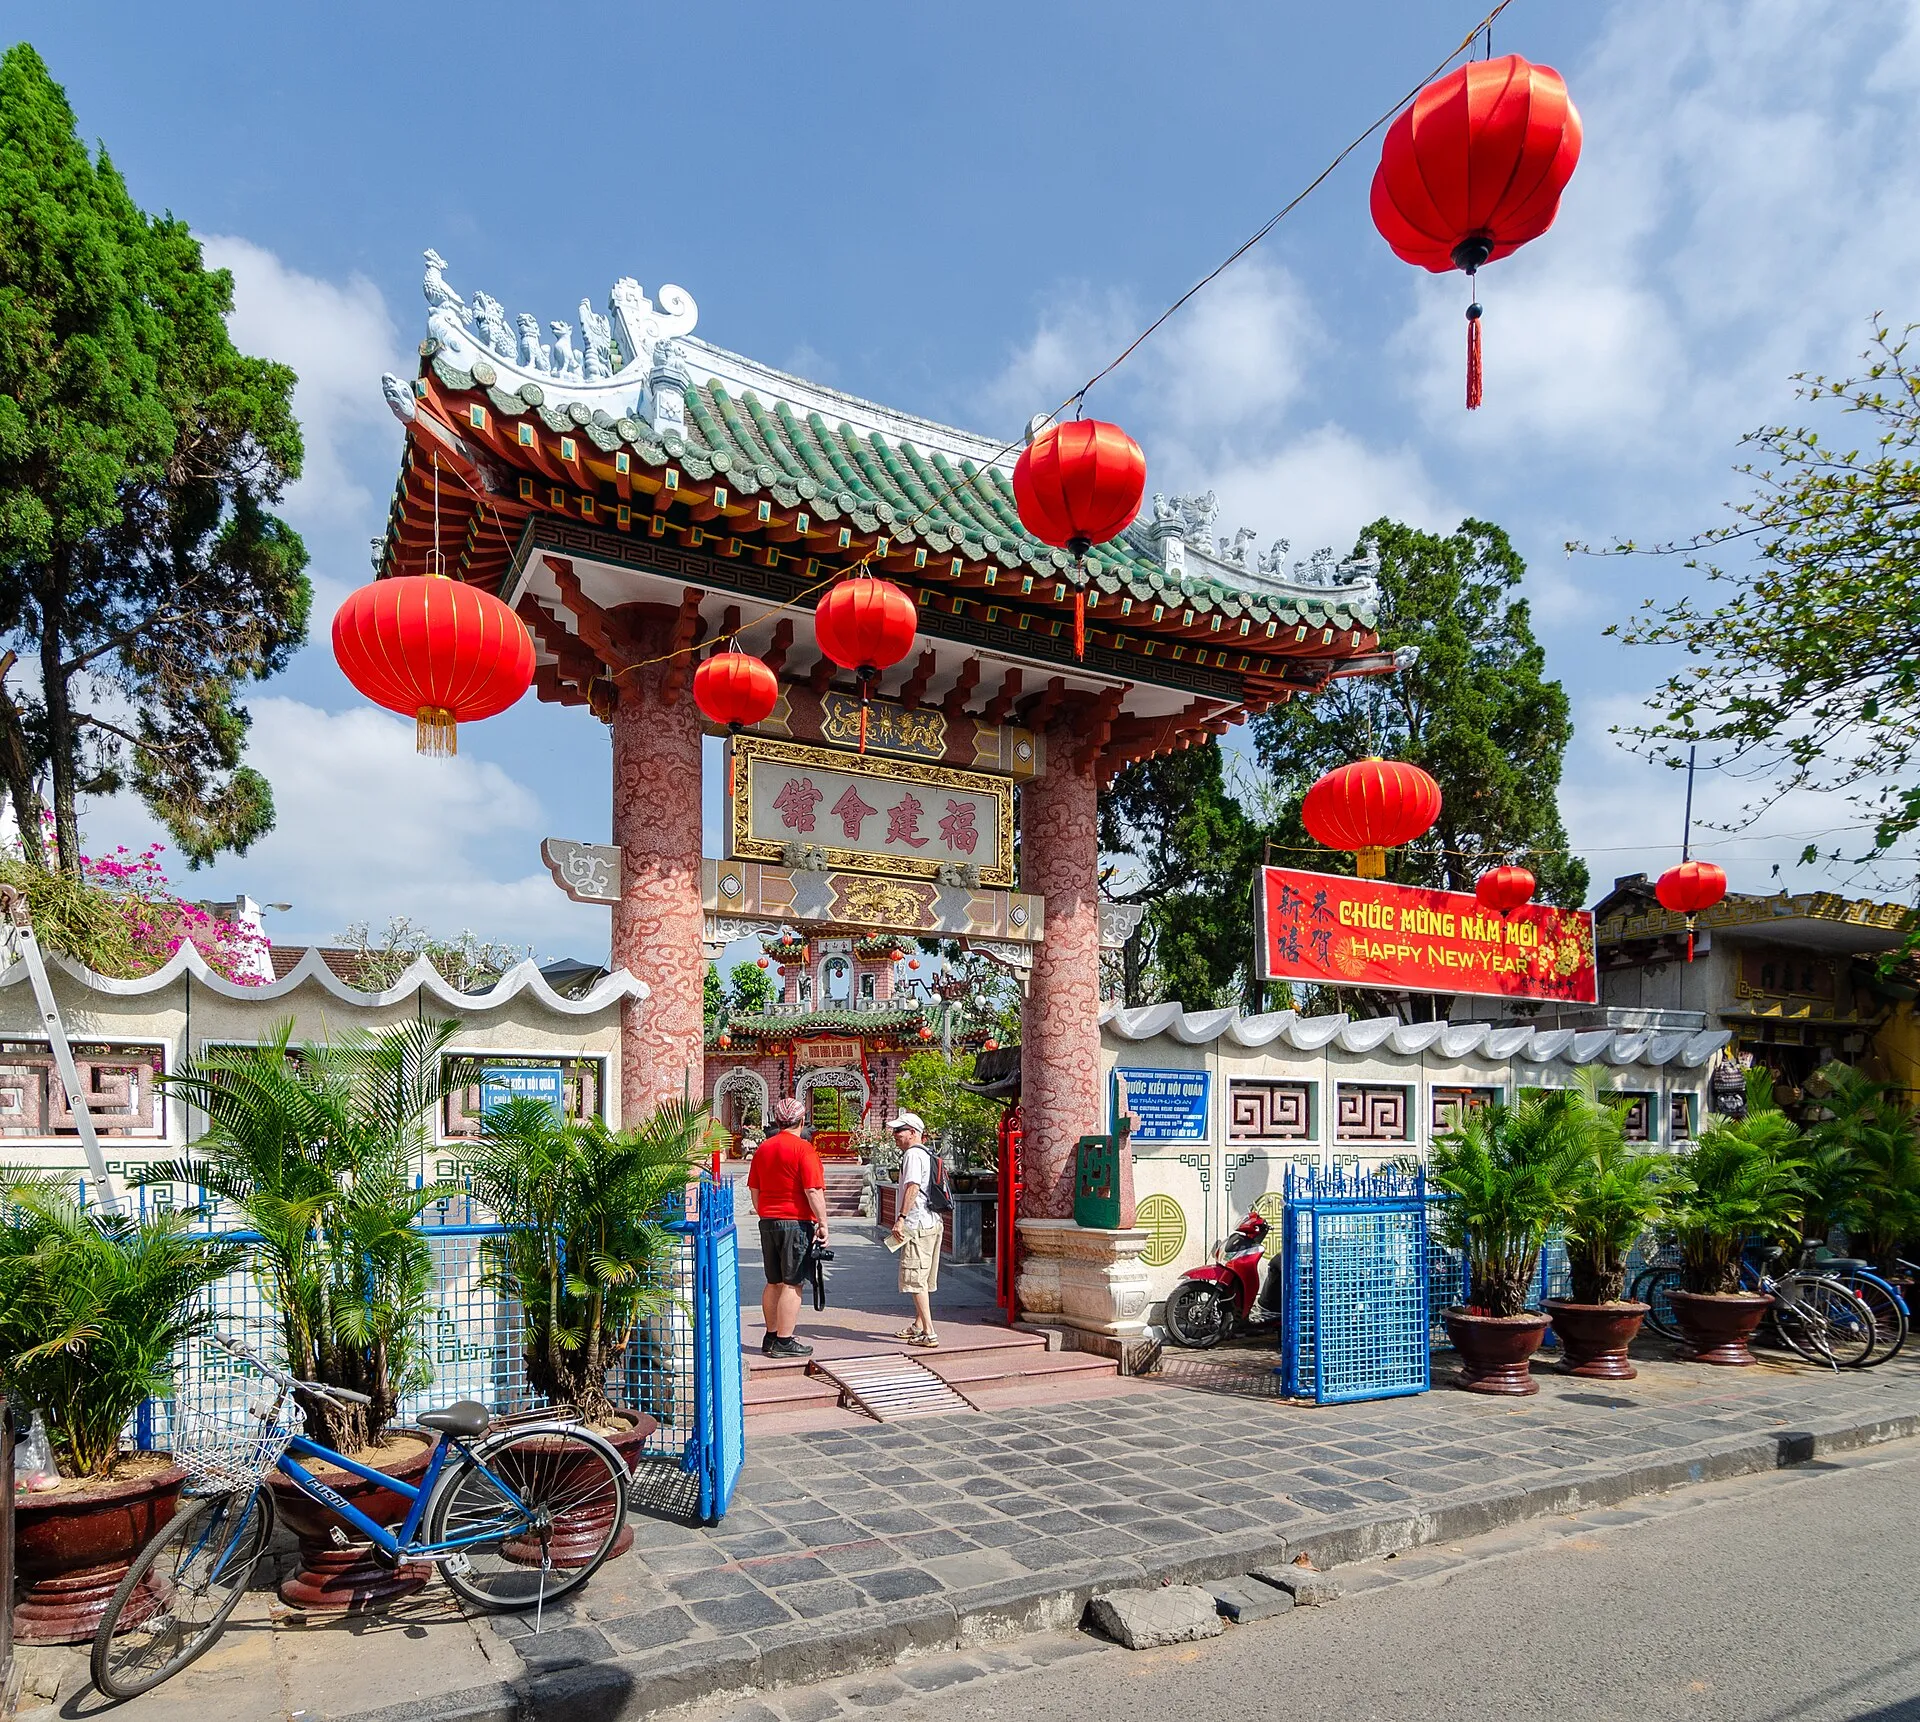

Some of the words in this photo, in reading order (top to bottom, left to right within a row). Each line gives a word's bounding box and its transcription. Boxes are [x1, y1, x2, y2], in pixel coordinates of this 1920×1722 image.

[1339, 899, 1395, 931] CHÚC
[1400, 904, 1455, 938] MỪNG
[1461, 912, 1501, 943] NĂM
[1505, 919, 1538, 948] MỚI
[1351, 936, 1423, 963] HAPPY
[1428, 944, 1475, 968] NEW
[1478, 950, 1528, 975] YEAR
[1148, 1078, 1166, 1096] KIẾN
[1167, 1080, 1181, 1098] HỘI
[1182, 1081, 1204, 1097] QUÁN
